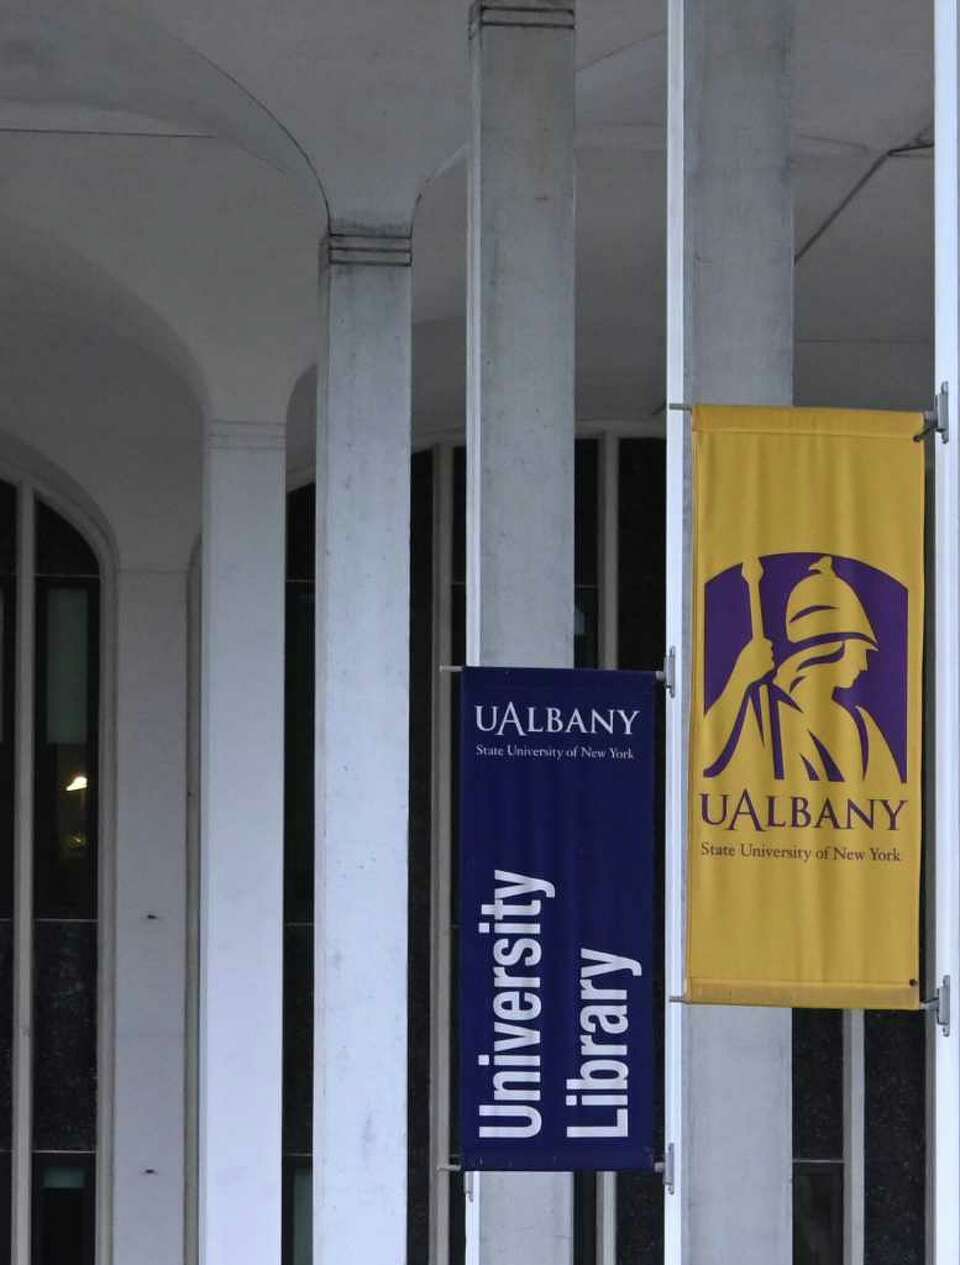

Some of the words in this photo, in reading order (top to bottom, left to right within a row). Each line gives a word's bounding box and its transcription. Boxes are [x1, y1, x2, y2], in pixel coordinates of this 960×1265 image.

[474, 701, 640, 736] UALBANY
[476, 744, 503, 756] State
[507, 745, 564, 760] University
[566, 746, 579, 758] of
[581, 747, 605, 758] New
[609, 748, 634, 760] York
[699, 789, 909, 832] UALBANY
[701, 842, 735, 856] State
[740, 844, 810, 863] University
[815, 846, 833, 861] of
[833, 847, 865, 861] New
[870, 847, 901, 862] York
[478, 870, 555, 1138] University
[566, 948, 642, 1138] Library
